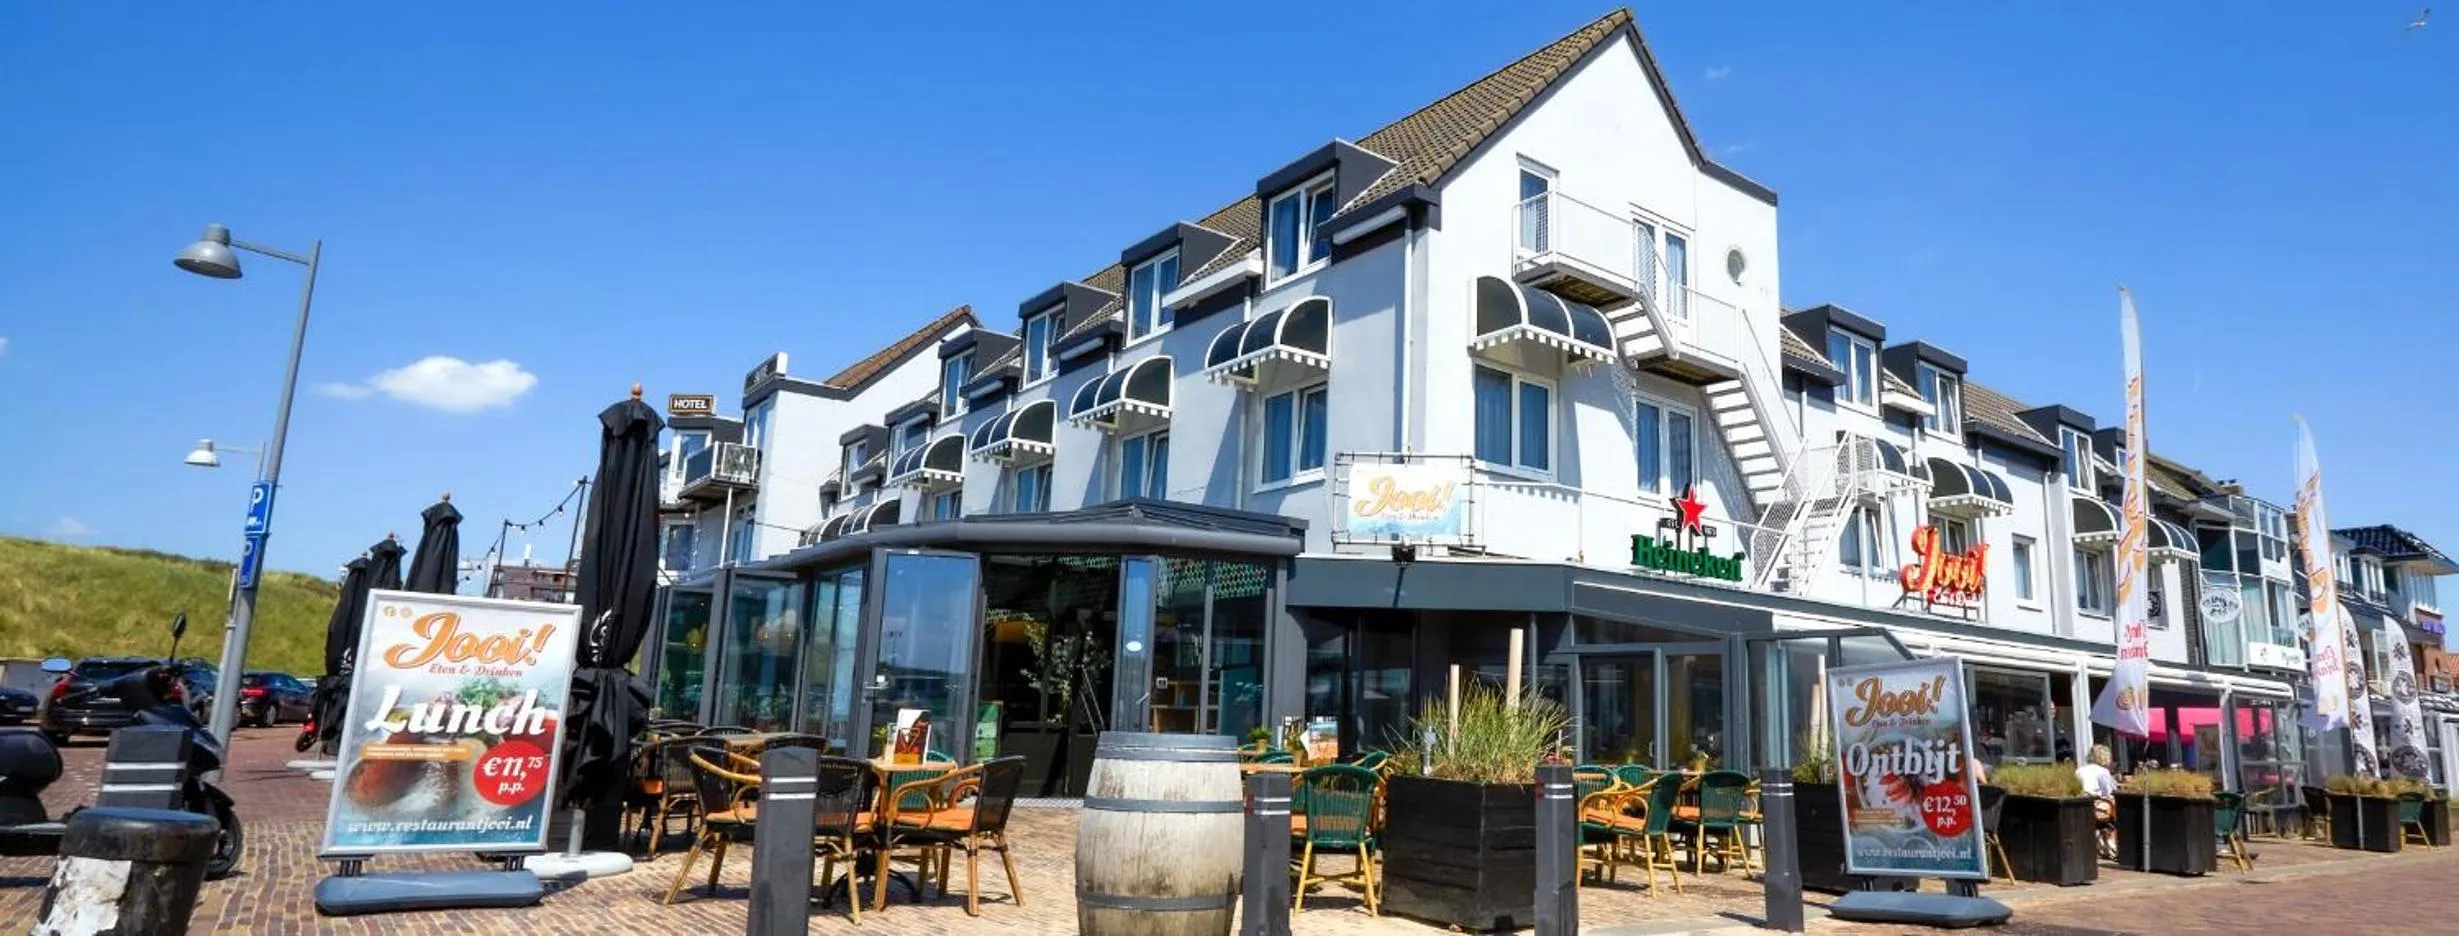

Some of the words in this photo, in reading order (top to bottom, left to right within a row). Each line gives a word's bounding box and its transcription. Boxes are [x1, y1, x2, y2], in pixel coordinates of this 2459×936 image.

[673, 399, 708, 409] HOTEL
[250, 488, 264, 513] P
[1354, 476, 1457, 517] Jooi!
[1630, 534, 1746, 582] Heineken
[1900, 526, 1991, 593] Jooi!
[383, 611, 557, 669] Jooi!
[429, 663, 456, 674] Eten
[475, 667, 523, 678] Drinken
[364, 685, 550, 735] Lunch
[1845, 674, 1947, 727] Jooi!
[1846, 737, 1962, 784] Ontbijt
[498, 781, 526, 795] p.p.
[348, 814, 533, 834] www.restaurantjooi.nl
[1937, 817, 1957, 828] p.p.
